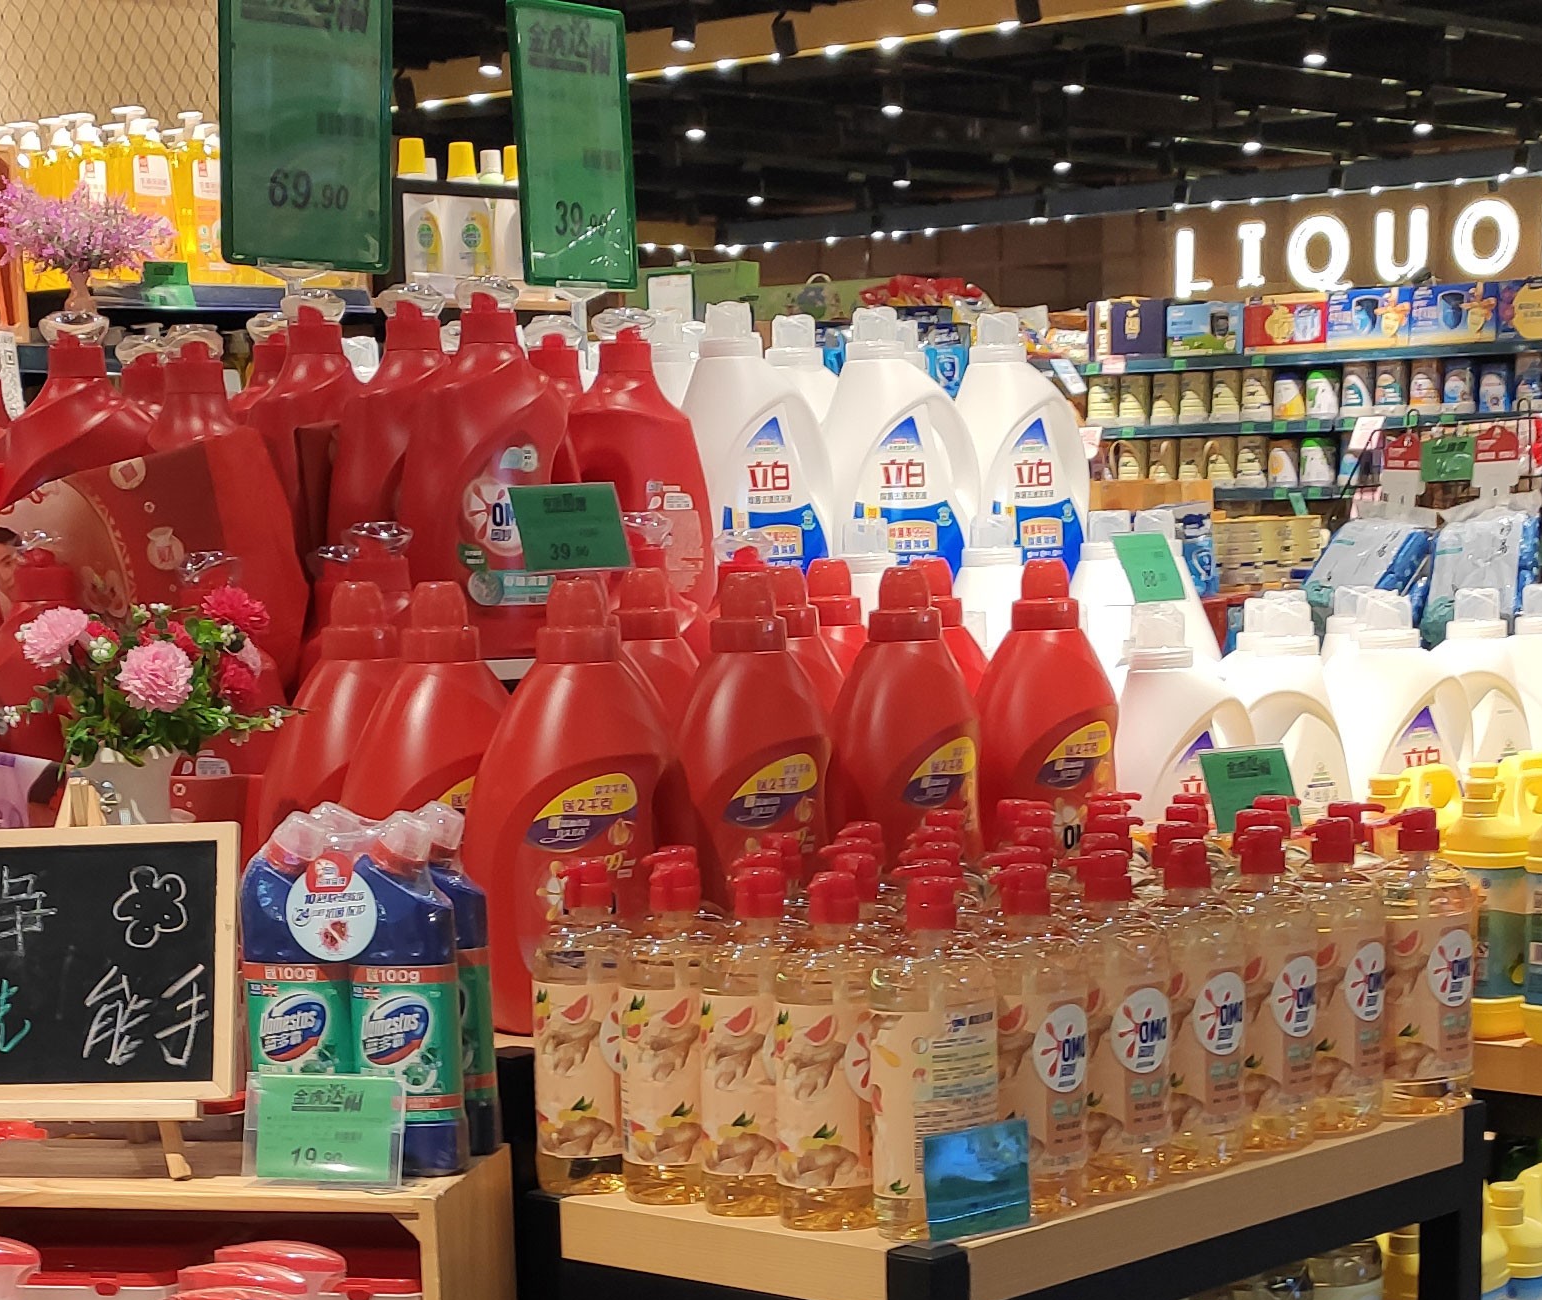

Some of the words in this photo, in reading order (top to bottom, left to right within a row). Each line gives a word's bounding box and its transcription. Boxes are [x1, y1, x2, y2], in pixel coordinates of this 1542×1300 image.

[267, 168, 350, 212] 69.90
[746, 461, 790, 493] 立白
[878, 458, 926, 489] 立白
[1013, 458, 1053, 487] 立白
[81, 963, 211, 1068] 能手
[260, 1009, 319, 1038] Domestos
[361, 1010, 421, 1038] Domestos
